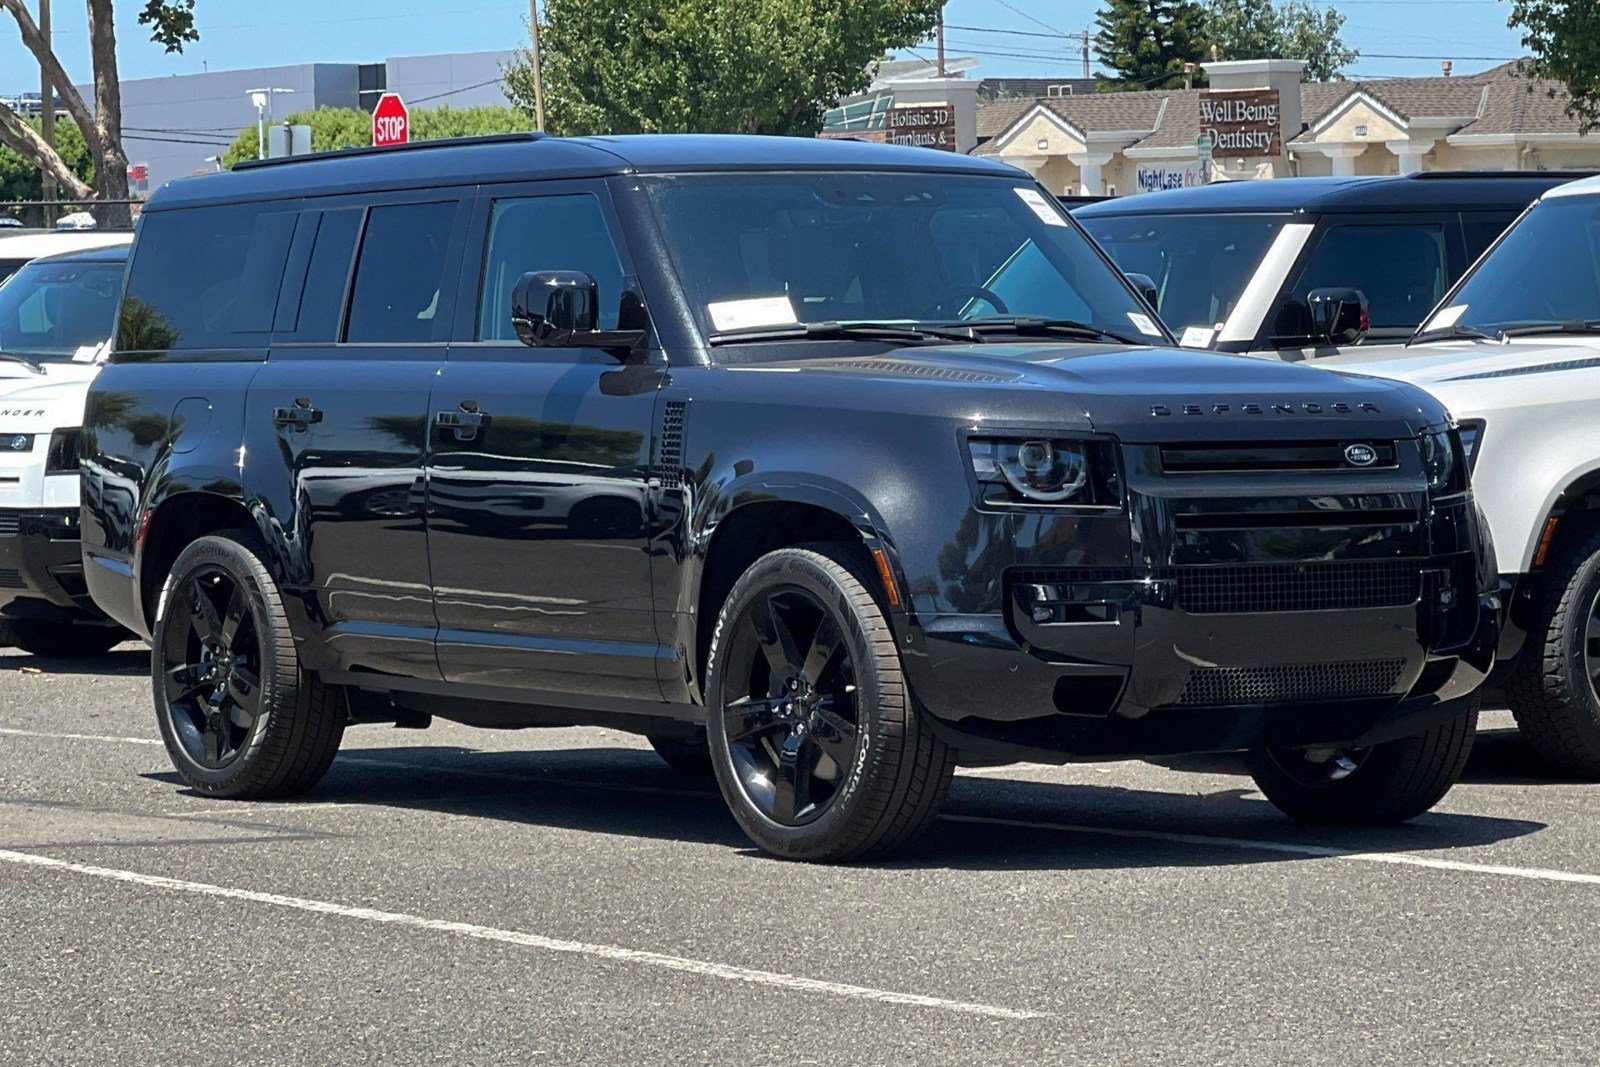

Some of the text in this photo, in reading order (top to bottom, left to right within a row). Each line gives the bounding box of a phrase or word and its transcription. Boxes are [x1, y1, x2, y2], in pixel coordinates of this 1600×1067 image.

[890, 109, 949, 127] Holistic 3D
[1201, 99, 1277, 127] Well Being
[377, 115, 406, 142] STOP
[890, 129, 947, 147] Implants &
[1206, 126, 1274, 154] Dentistry
[1149, 402, 1381, 417] DEFENDER
